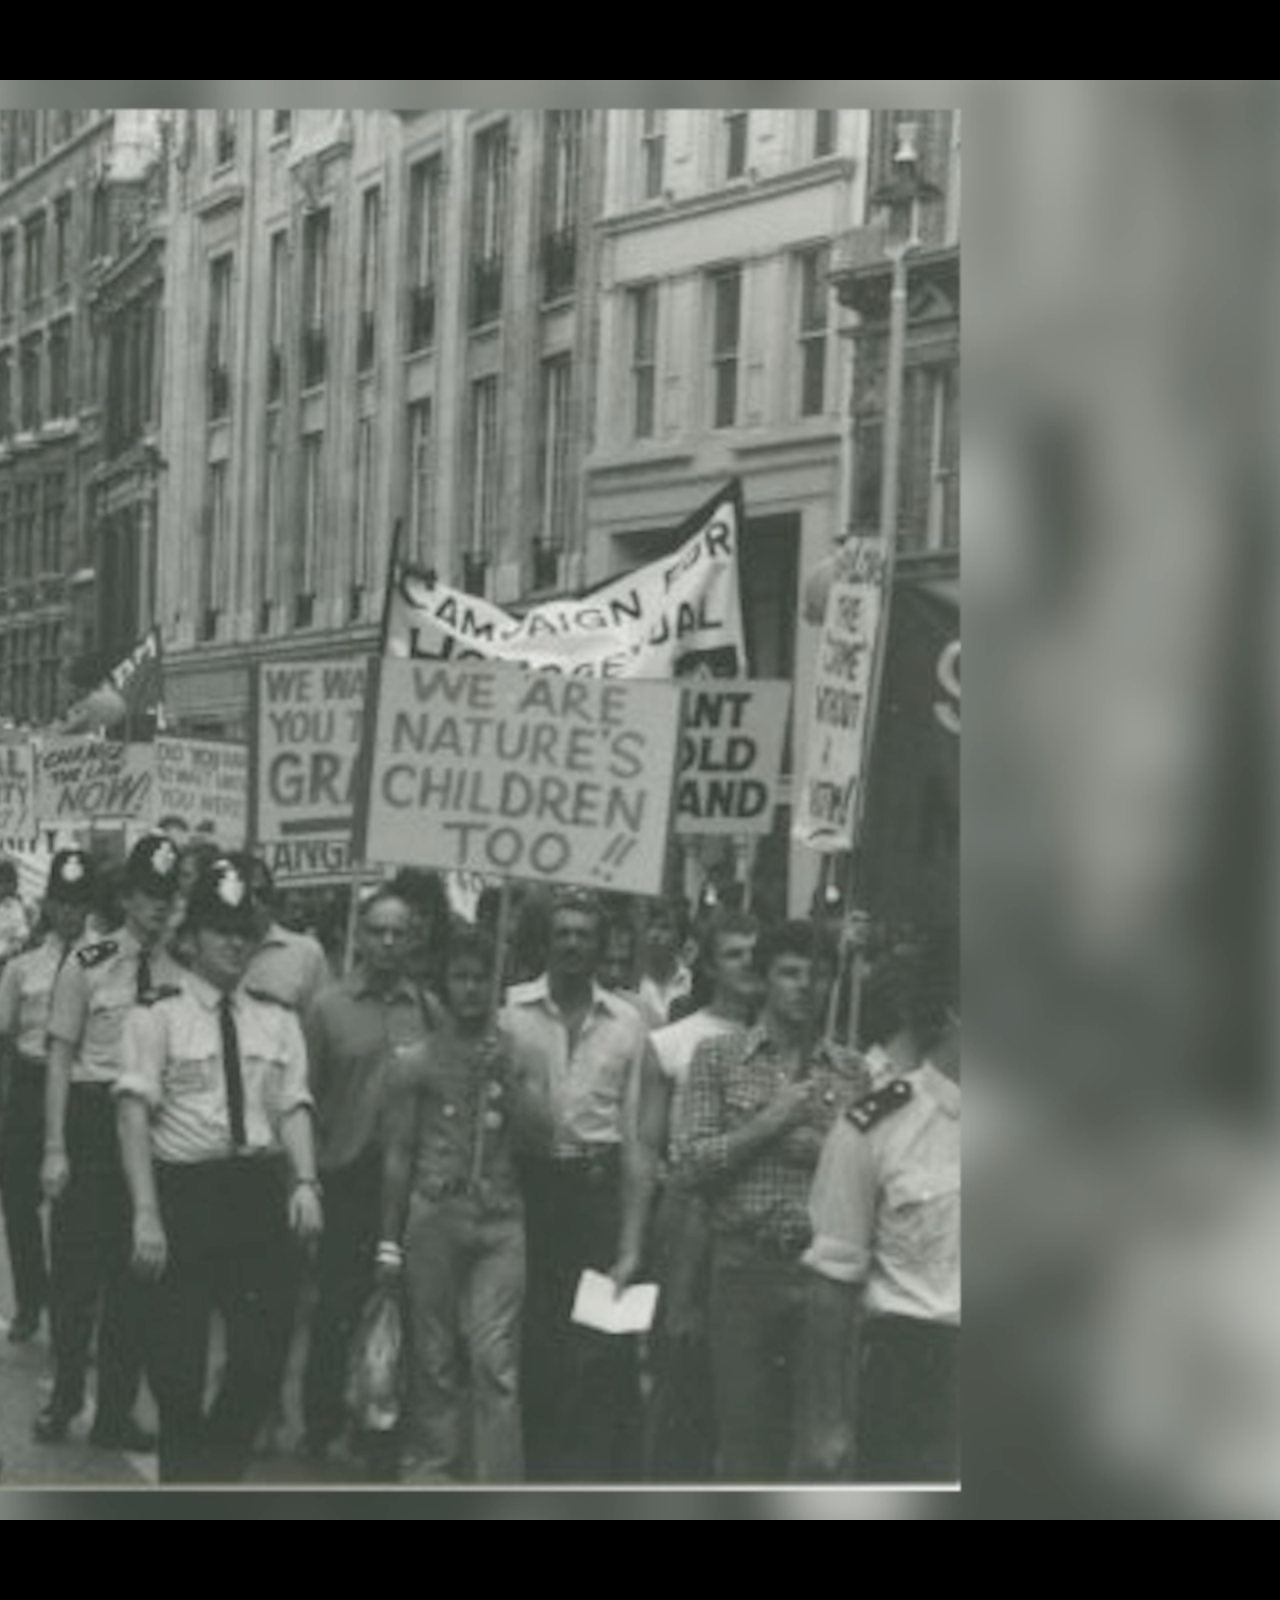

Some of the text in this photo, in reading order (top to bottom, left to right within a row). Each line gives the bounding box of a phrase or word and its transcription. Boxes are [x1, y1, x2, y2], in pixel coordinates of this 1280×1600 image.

[266, 667, 313, 703] WE
[411, 666, 630, 727] WE ARE
[268, 708, 335, 744] YOU
[390, 709, 646, 779] NATURE'S
[56, 771, 151, 815] NOW!
[270, 752, 354, 807] GR
[380, 763, 646, 833] CHILDREN
[442, 820, 572, 874] TOO
